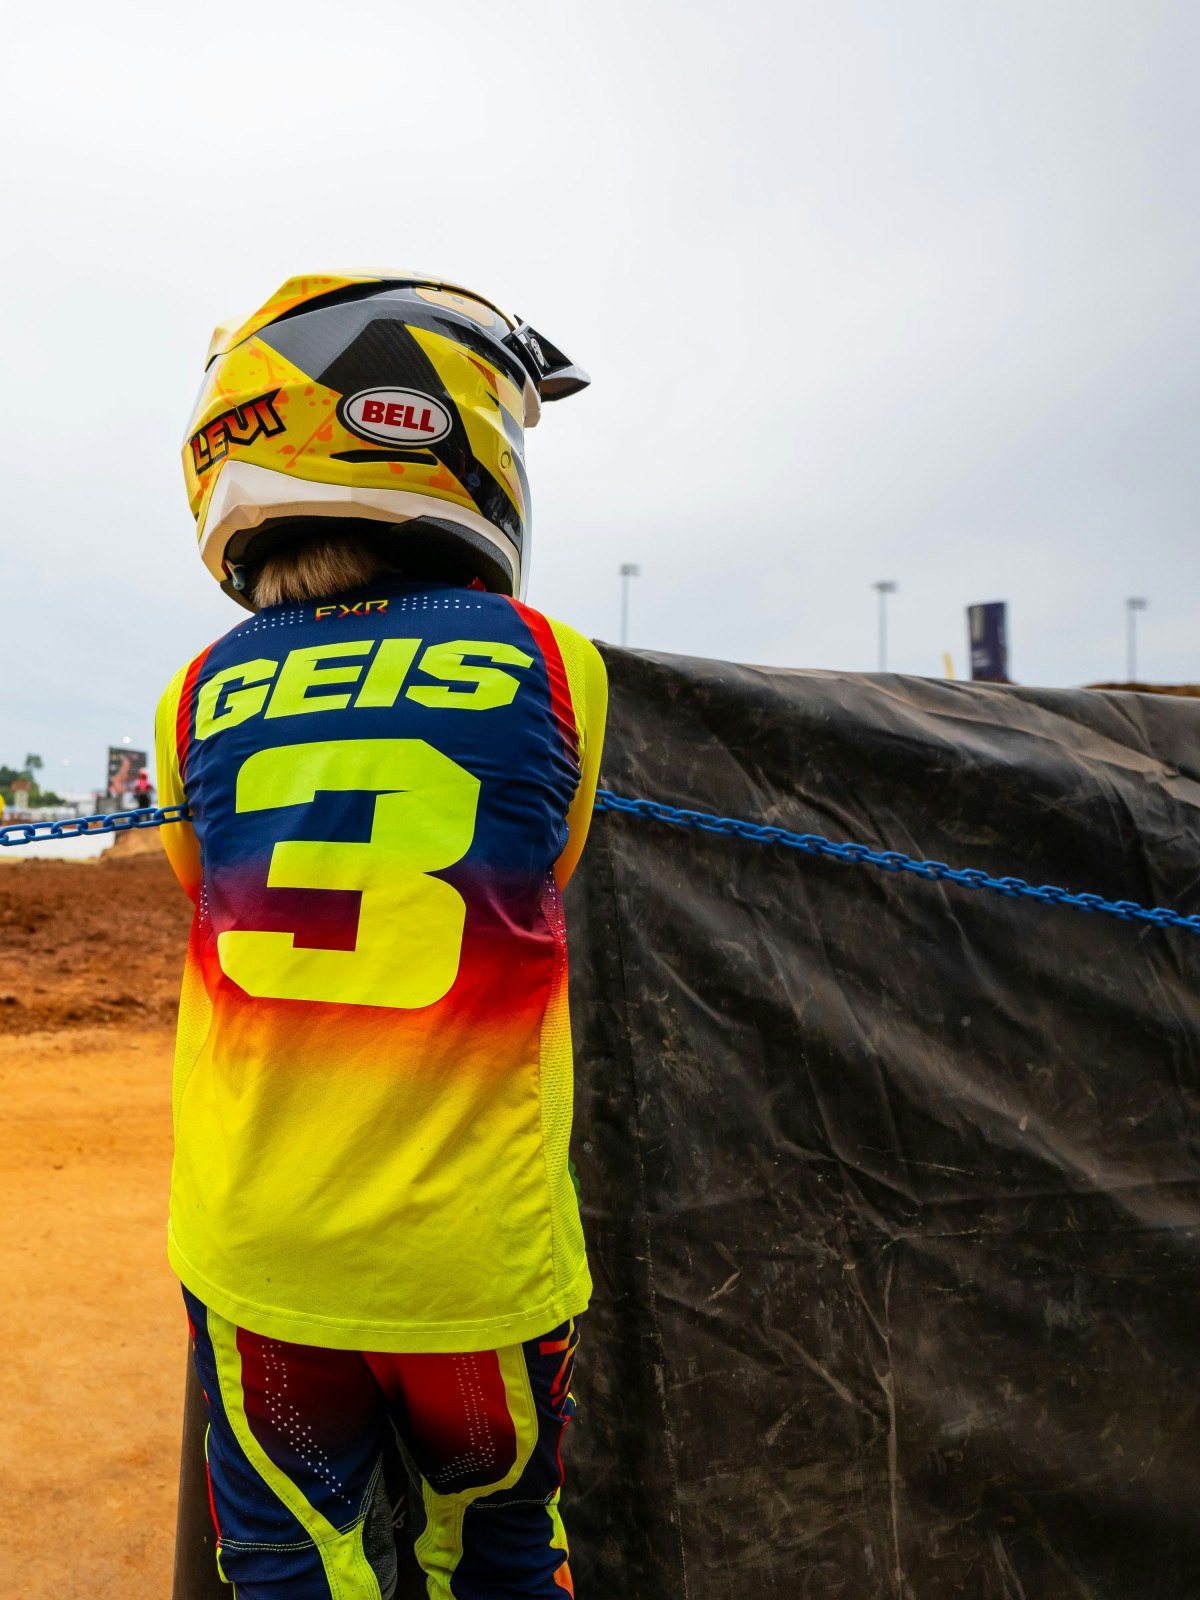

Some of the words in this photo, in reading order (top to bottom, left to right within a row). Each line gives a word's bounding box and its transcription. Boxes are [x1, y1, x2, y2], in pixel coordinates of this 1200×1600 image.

[190, 391, 285, 473] LEVI
[361, 400, 435, 433] BELL
[315, 599, 389, 621] FXR
[195, 638, 533, 741] GEIS
[217, 738, 481, 1009] 3
